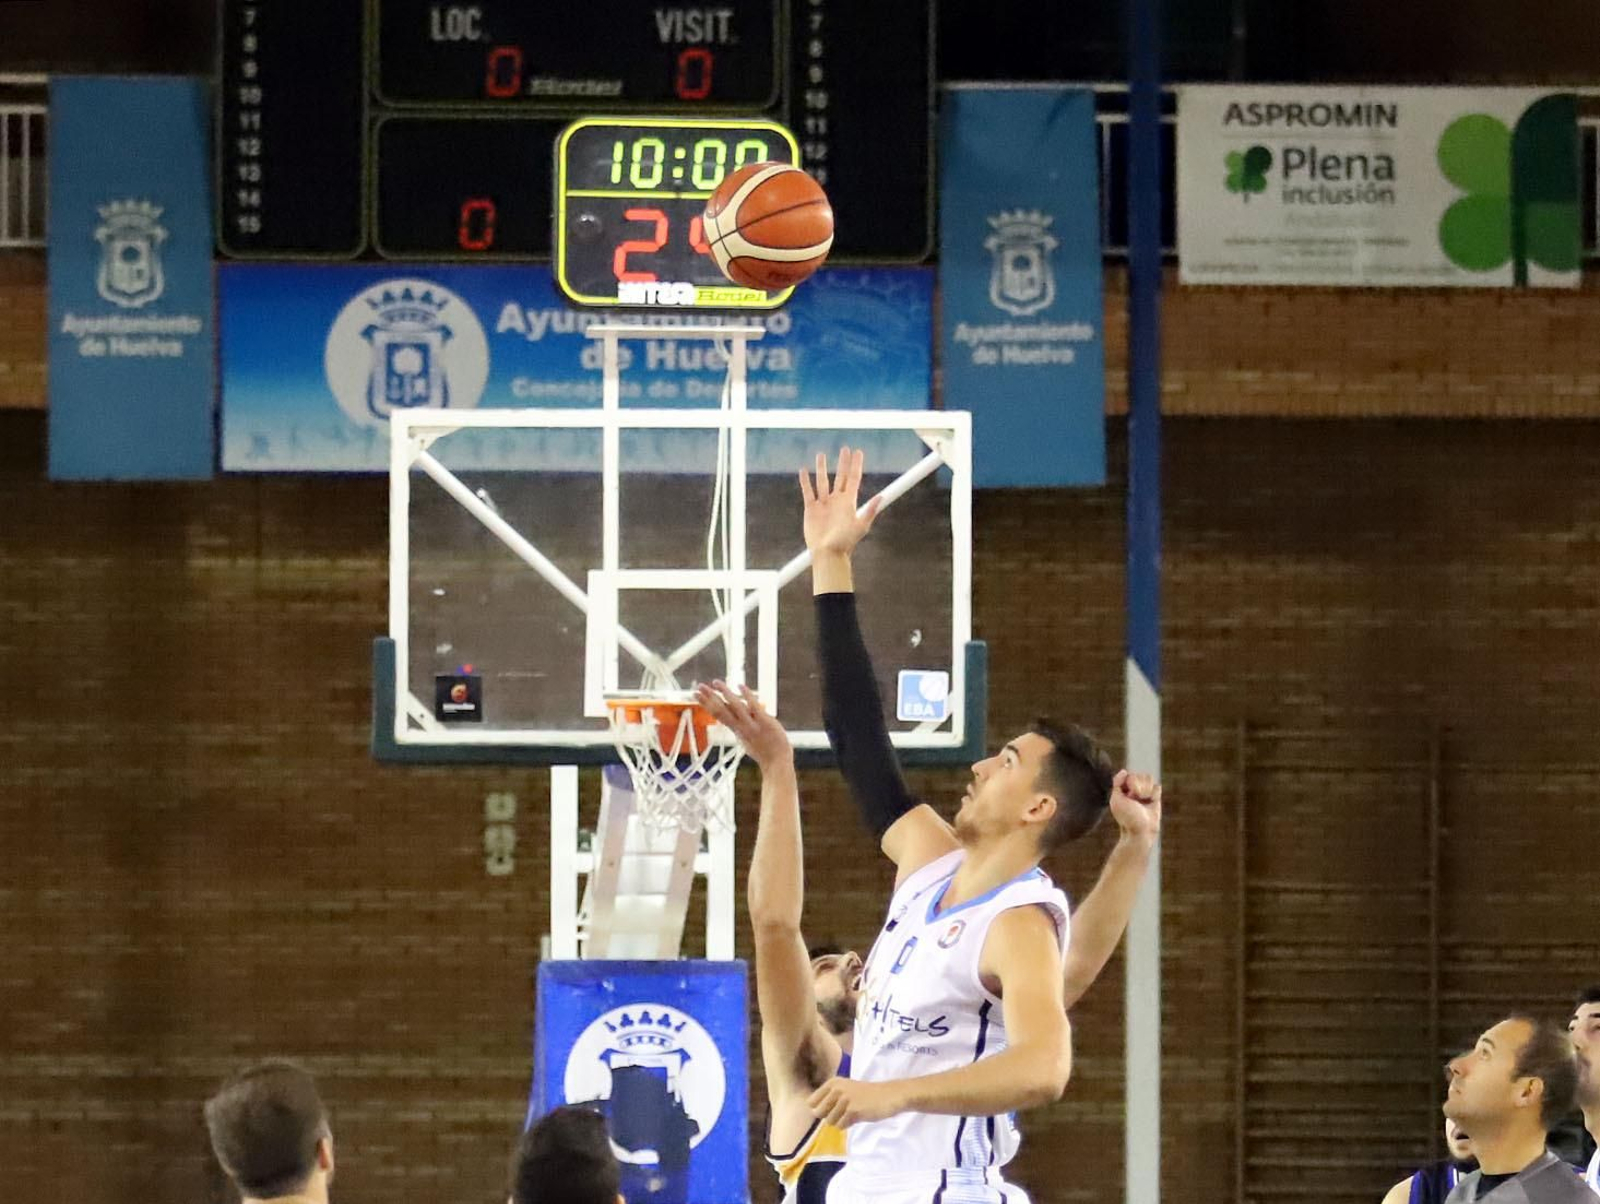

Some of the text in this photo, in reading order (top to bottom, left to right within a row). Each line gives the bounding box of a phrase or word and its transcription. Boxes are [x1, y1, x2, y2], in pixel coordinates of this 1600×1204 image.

[487, 46, 522, 97] 0
[676, 48, 713, 98] 0
[1224, 102, 1397, 127] ASPROMIN
[238, 138, 261, 157] 12
[239, 163, 262, 183] 13
[1282, 146, 1394, 181] Plena
[1282, 183, 1395, 204] inclusión
[460, 199, 495, 249] 0
[953, 322, 1095, 346] Ayuntamiento
